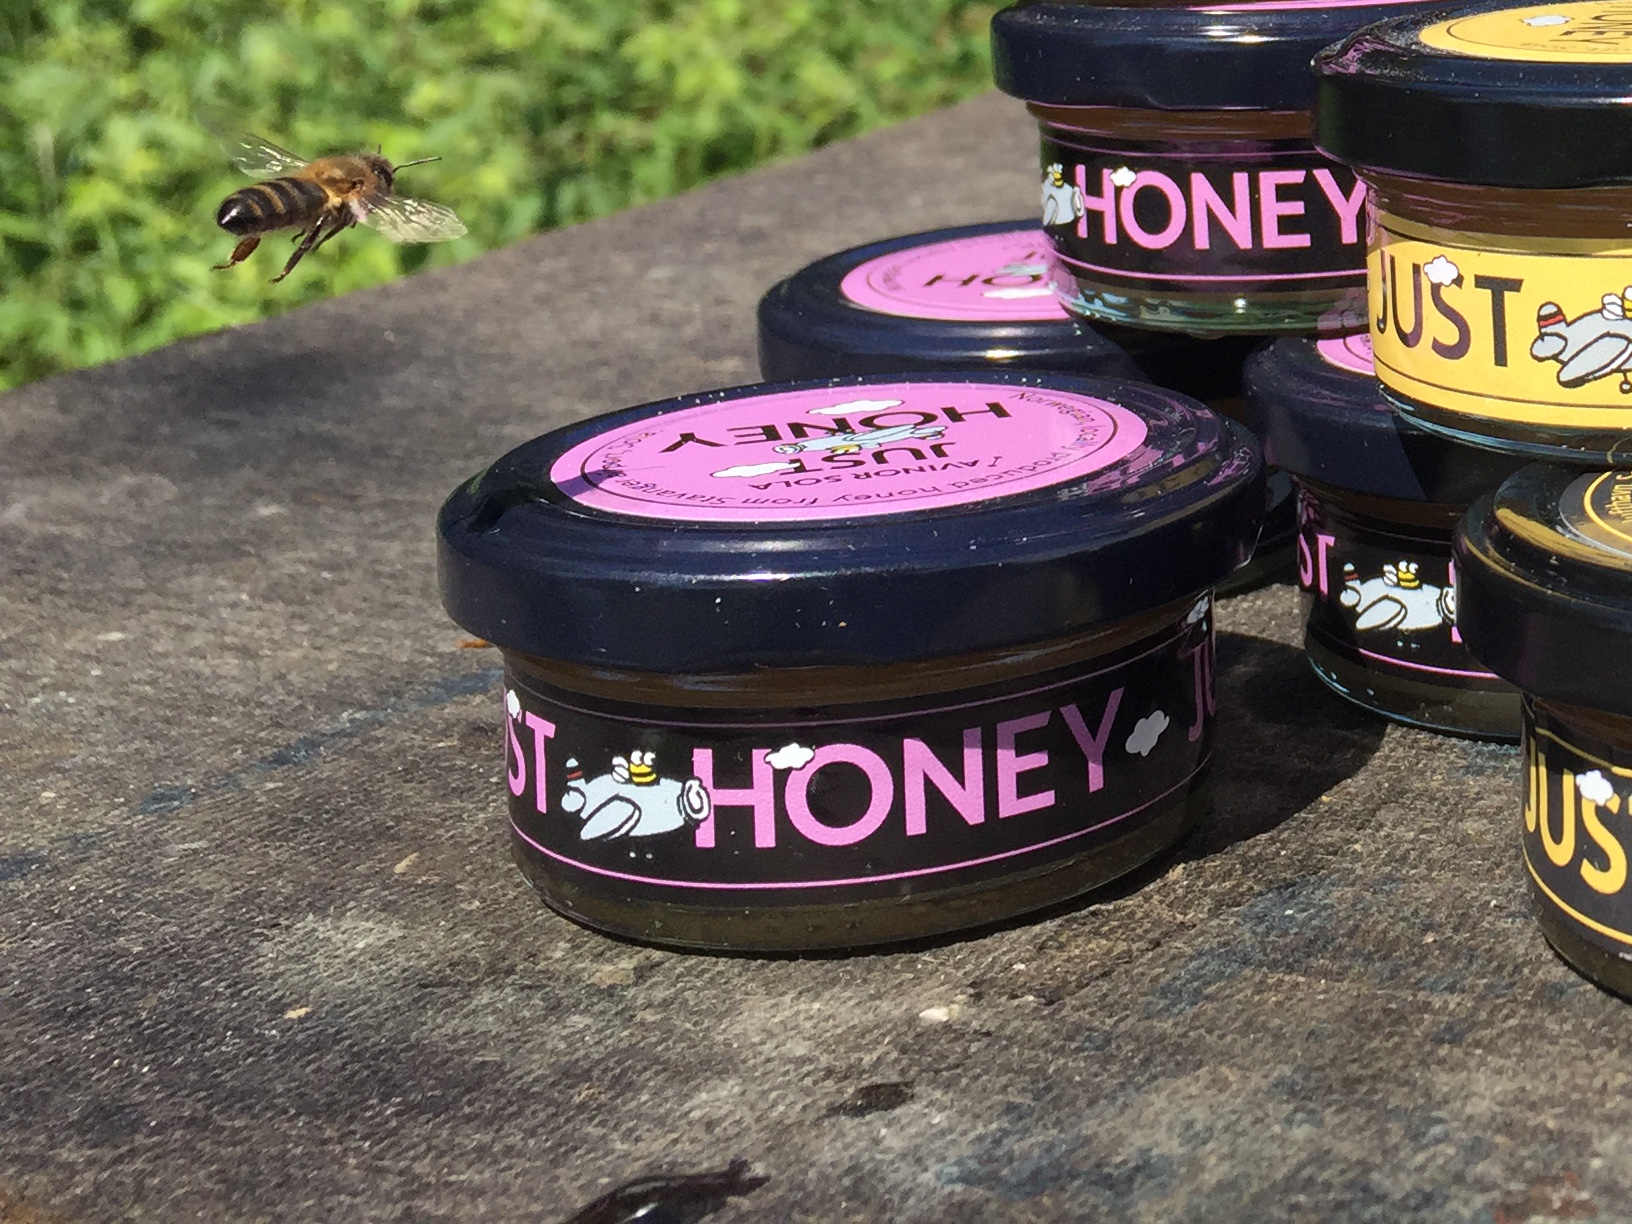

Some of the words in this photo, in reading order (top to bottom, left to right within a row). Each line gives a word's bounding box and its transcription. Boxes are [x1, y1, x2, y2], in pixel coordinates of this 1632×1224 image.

[1075, 163, 1368, 251] HONEY
[1376, 248, 1525, 368] JUST
[658, 401, 1012, 454] HONEY
[779, 441, 956, 477] JUST
[852, 458, 980, 481] AVINOR
[954, 450, 1073, 488] produced
[748, 474, 843, 492] SOLA
[831, 485, 943, 504] honey
[740, 496, 818, 508] from
[504, 706, 557, 814] ST
[693, 687, 1126, 850] HONEY
